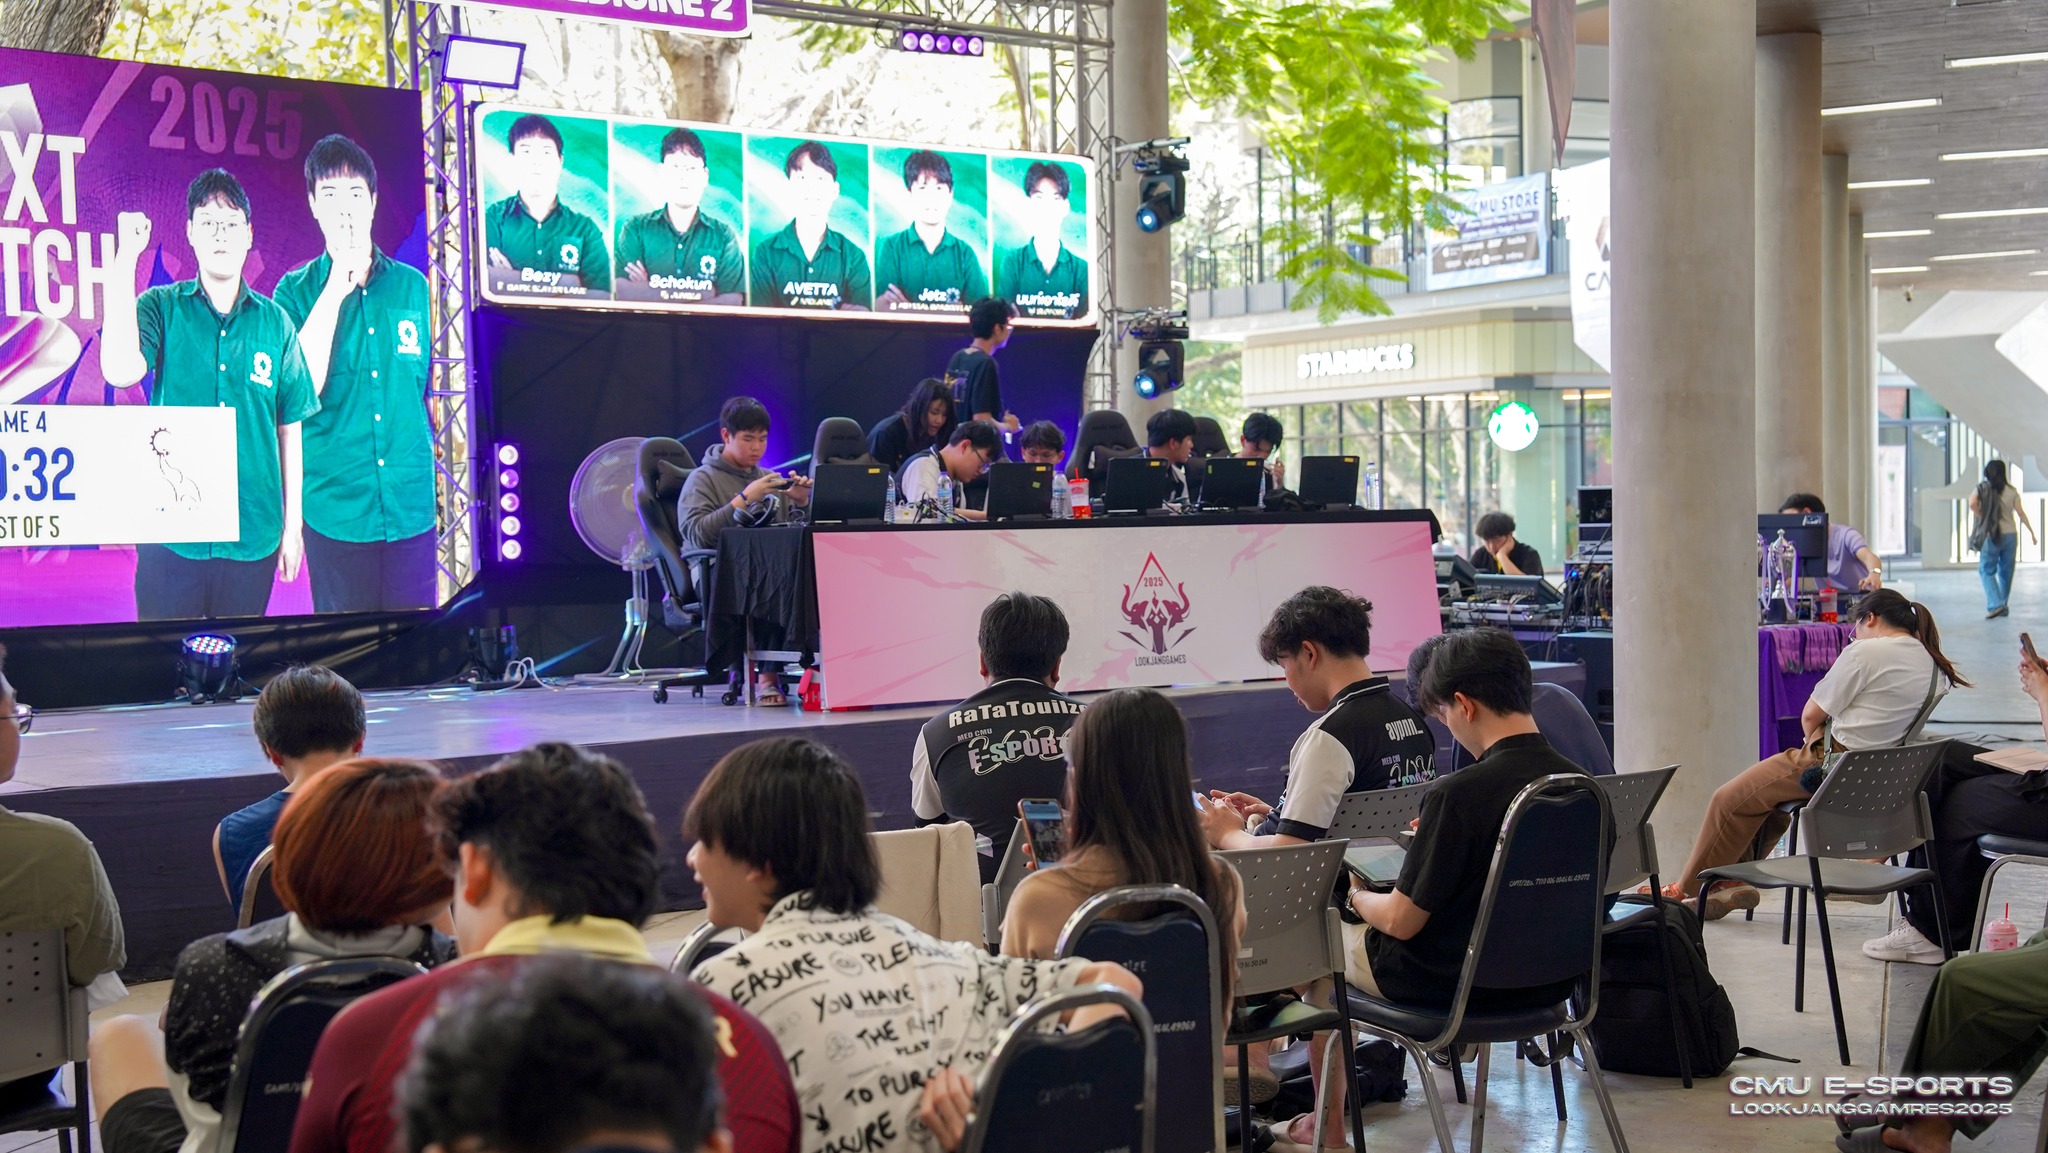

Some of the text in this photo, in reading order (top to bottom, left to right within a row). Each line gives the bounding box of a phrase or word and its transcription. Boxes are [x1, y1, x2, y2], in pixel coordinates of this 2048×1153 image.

[149, 75, 302, 160] 2025
[1502, 191, 1538, 210] STORE
[783, 281, 838, 296] AVETTA
[1297, 343, 1415, 379] STARBUCKS
[0, 410, 46, 432] ME 4
[24, 516, 43, 538] OF
[50, 516, 59, 538] 5
[1144, 577, 1163, 587] 2025
[1135, 654, 1187, 666] LOOKJANGGAMES
[957, 728, 993, 742] MED CMU
[797, 926, 875, 945] PURSUE
[809, 983, 914, 1024] YOU HAVE
[856, 1020, 900, 1050] THE
[844, 1088, 873, 1106] TO
